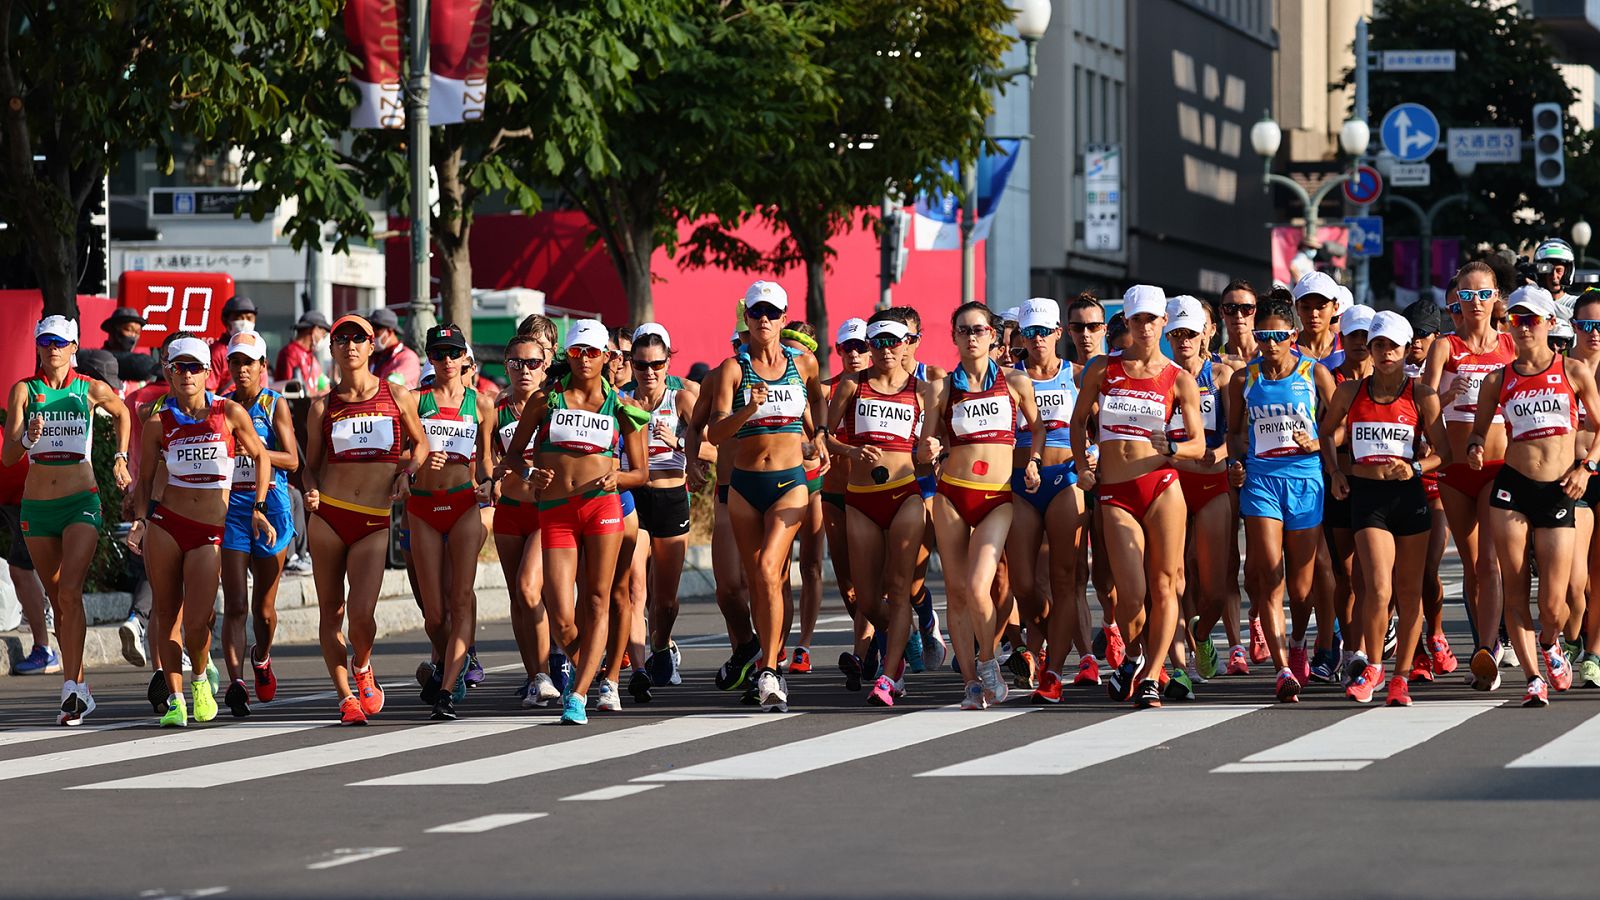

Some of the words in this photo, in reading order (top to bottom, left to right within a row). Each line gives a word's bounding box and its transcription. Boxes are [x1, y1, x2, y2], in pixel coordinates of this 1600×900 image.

[462, 55, 488, 122] 2020
[154, 255, 264, 268] 大通駅エレベーター
[141, 285, 212, 332] 20
[765, 389, 793, 403] ENA
[1108, 387, 1165, 402] ESPAÑA
[858, 403, 912, 421] QIEYANG
[964, 401, 999, 419] YANG
[1107, 402, 1162, 417] GARCIA-CARO
[1249, 402, 1308, 420] INDIA
[1513, 399, 1561, 417] OKADA
[352, 420, 373, 434] LIU
[555, 413, 610, 431] ORTUNO
[978, 419, 987, 427] 23
[1259, 420, 1306, 434] PRIYANKA
[40, 426, 84, 437] BECINHA
[575, 429, 588, 437] 141
[1356, 427, 1410, 442] BEKMEZ
[169, 432, 221, 447] ESPAÑA
[359, 436, 368, 444] 20
[177, 447, 218, 462] PEREZ
